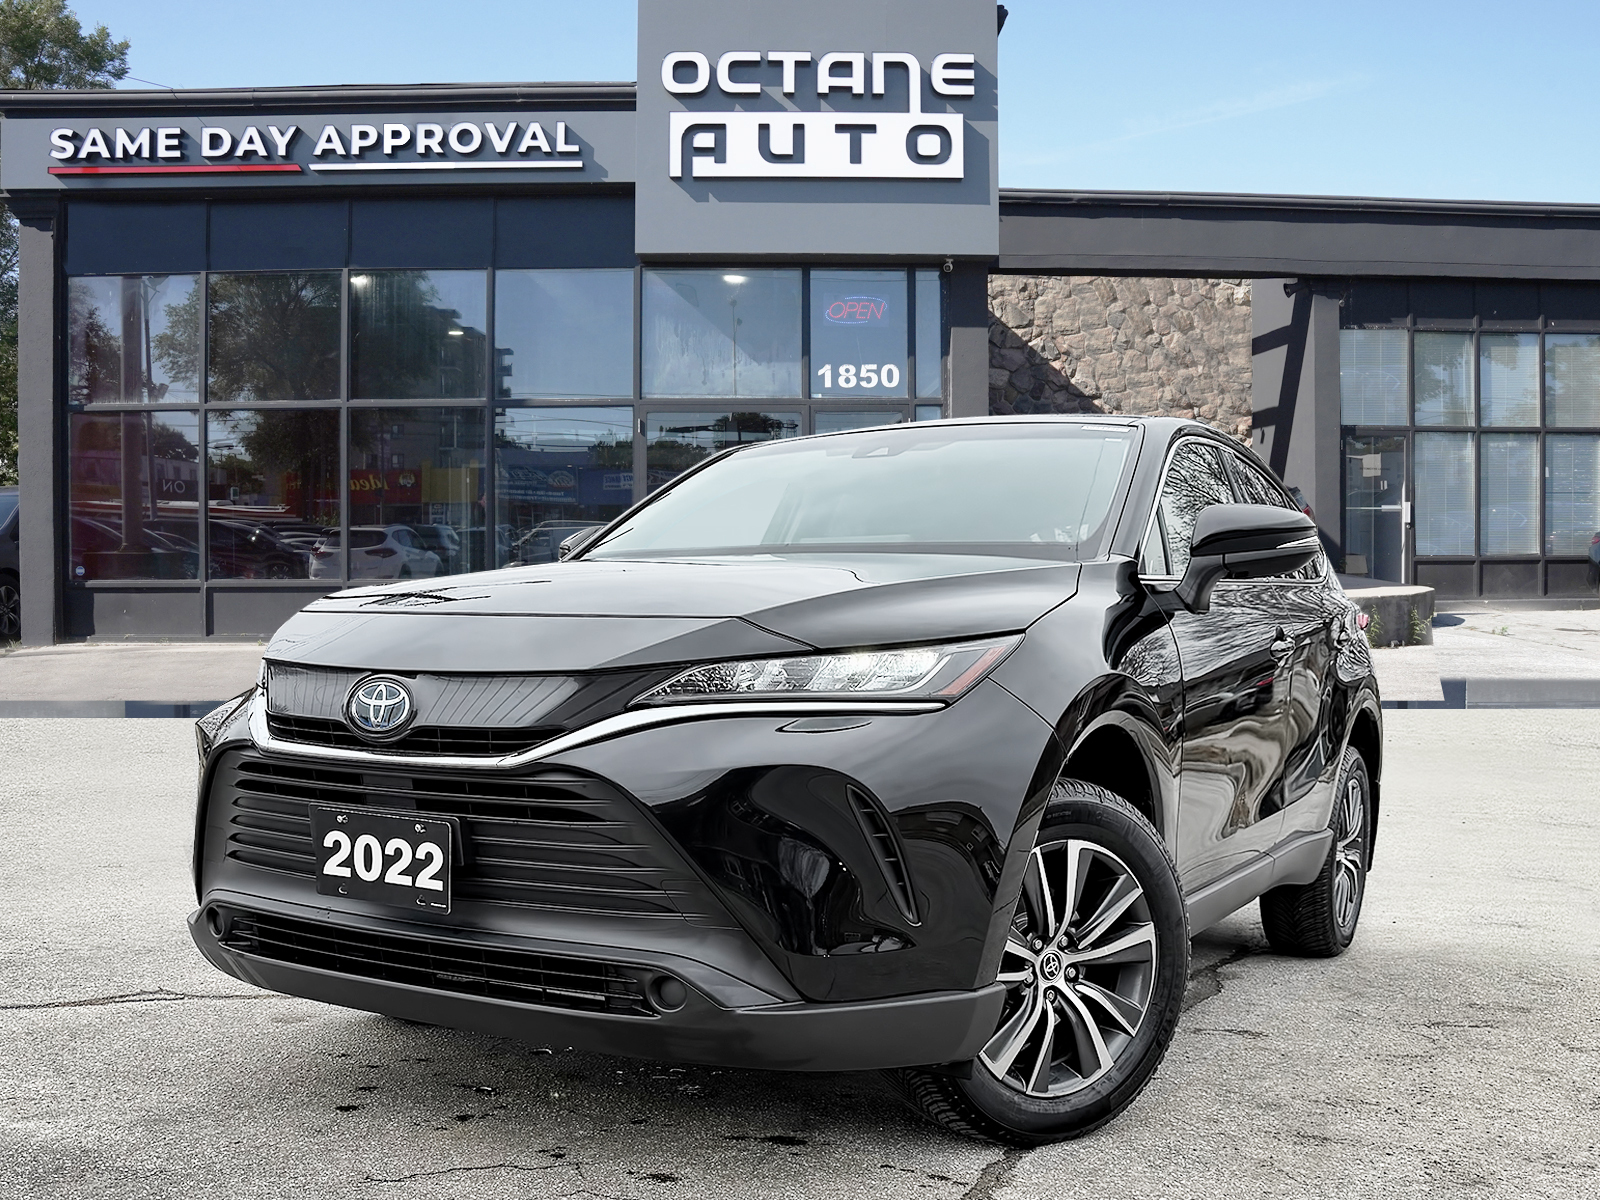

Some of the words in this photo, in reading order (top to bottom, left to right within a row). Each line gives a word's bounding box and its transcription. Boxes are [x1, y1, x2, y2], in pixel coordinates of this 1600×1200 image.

[661, 51, 975, 112] OCTANE
[49, 127, 182, 160] SAME
[200, 124, 298, 158] DAY
[312, 120, 580, 157] APPROVAL
[681, 123, 953, 178] AUTO
[828, 301, 885, 320] OPEN
[817, 363, 900, 389] 1850
[322, 830, 444, 892] 2022
